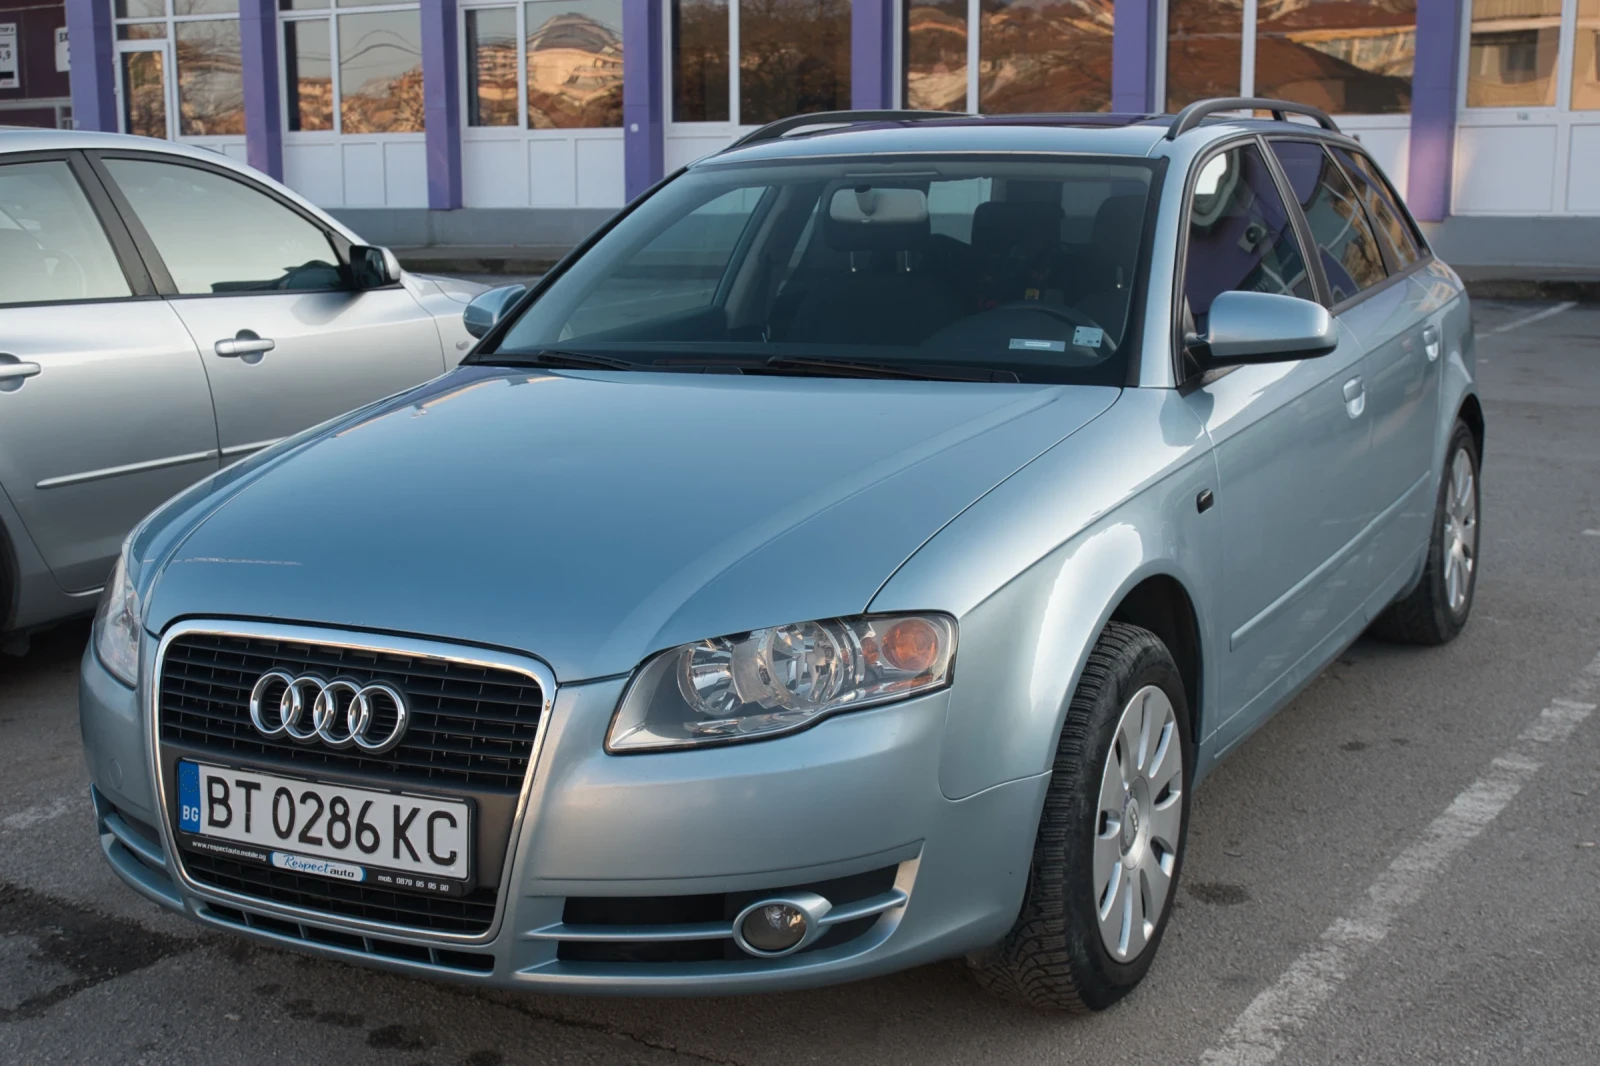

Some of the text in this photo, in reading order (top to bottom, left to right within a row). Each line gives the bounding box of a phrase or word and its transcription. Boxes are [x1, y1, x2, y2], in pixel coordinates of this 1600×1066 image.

[182, 805, 199, 822] BG
[206, 775, 458, 866] BT 0286 KC
[192, 840, 267, 862] www.respectauto.mobile.bg
[283, 853, 355, 878] Respect auto
[377, 875, 449, 892] mob. 0879 95 95 90
